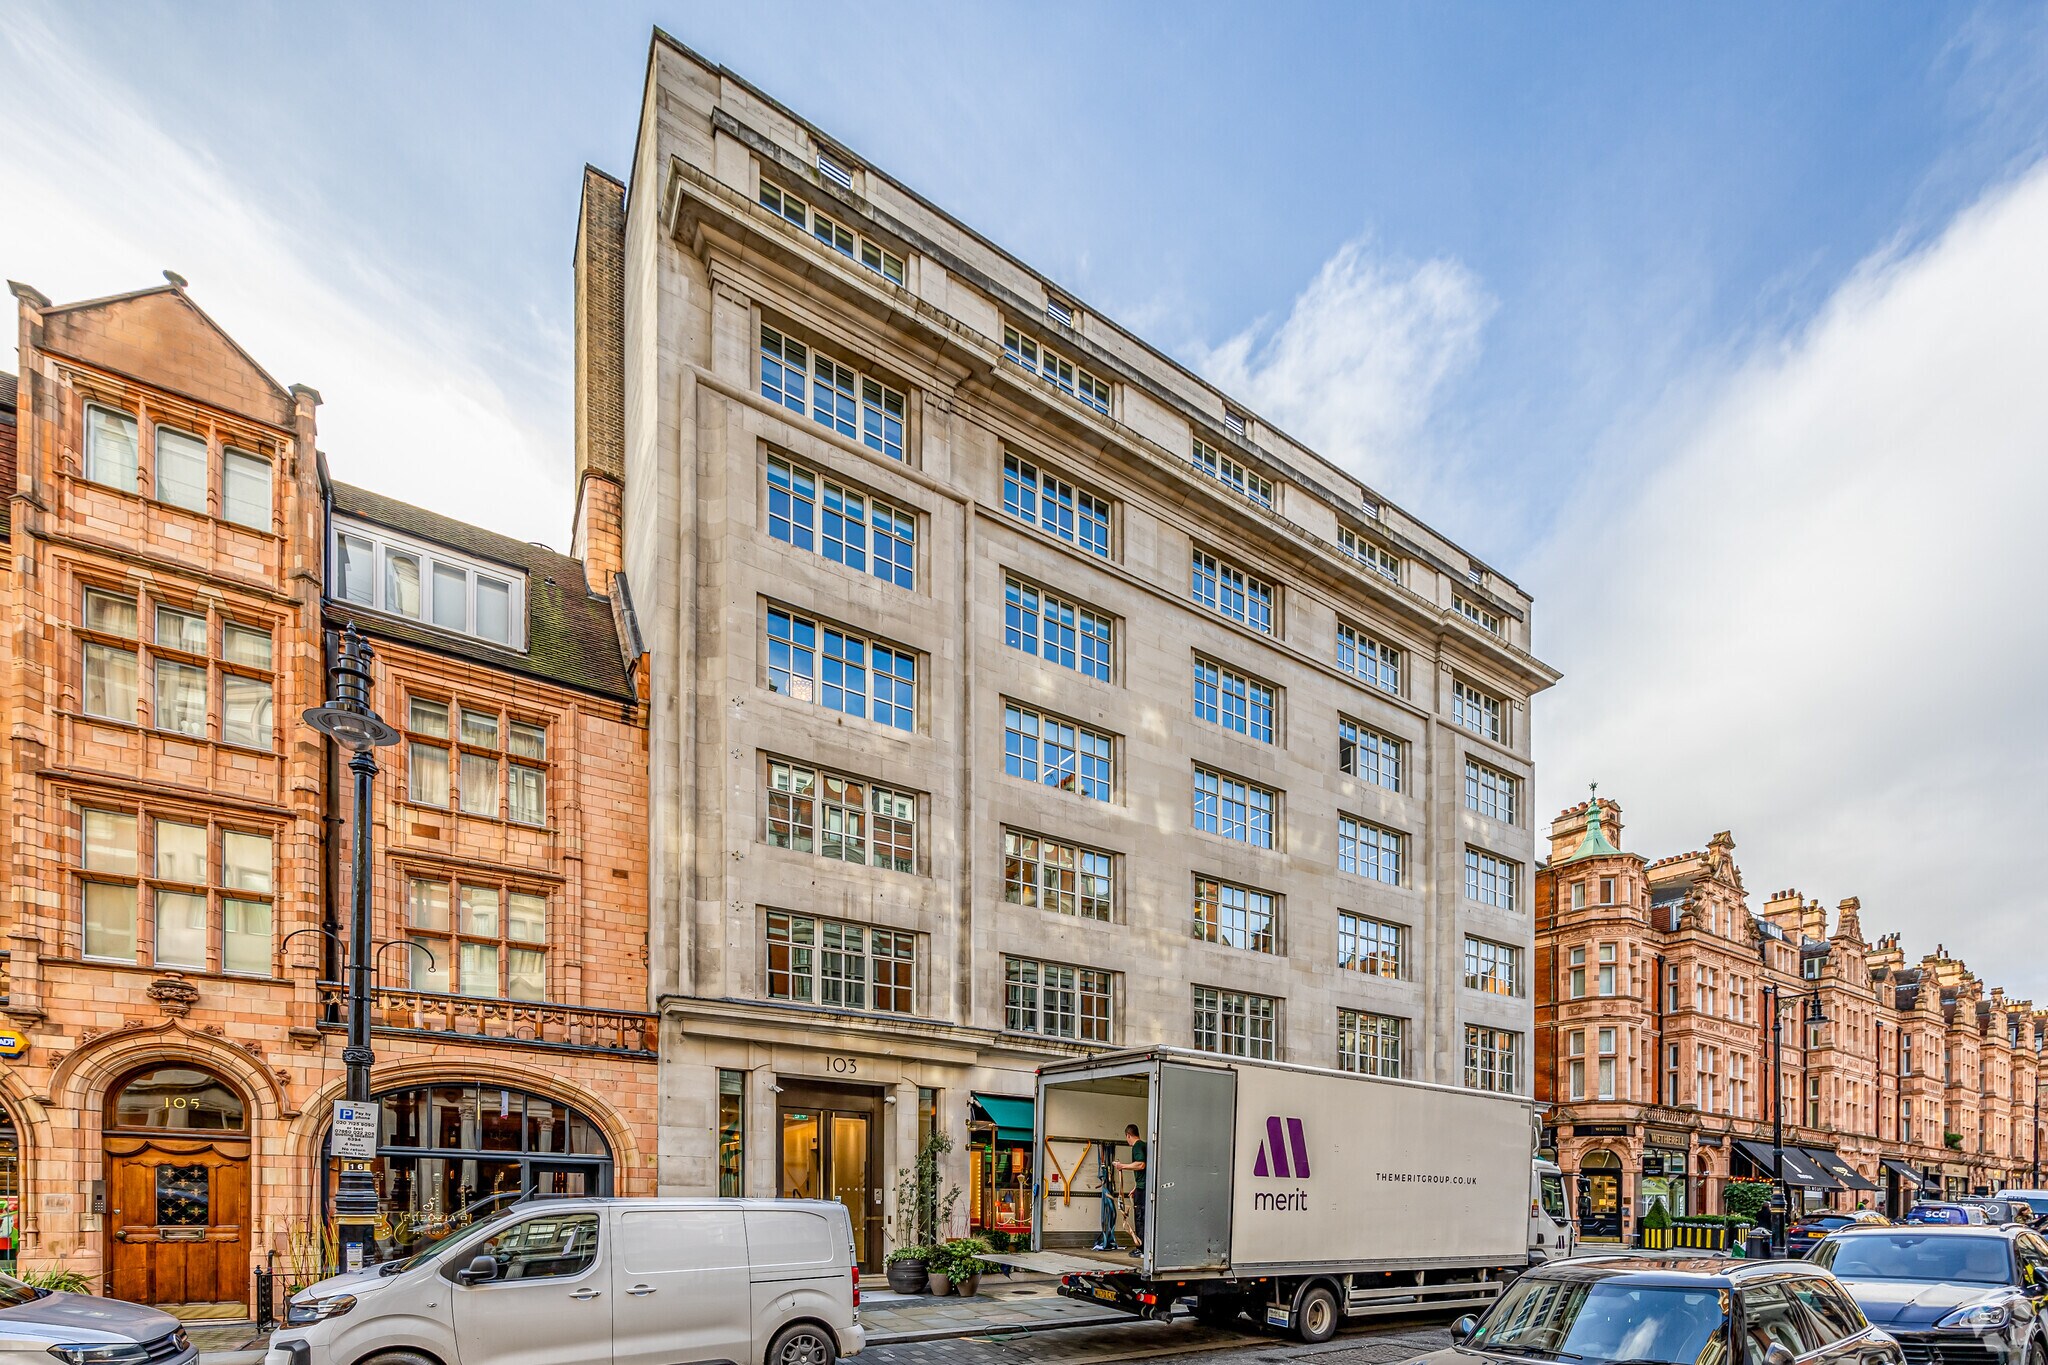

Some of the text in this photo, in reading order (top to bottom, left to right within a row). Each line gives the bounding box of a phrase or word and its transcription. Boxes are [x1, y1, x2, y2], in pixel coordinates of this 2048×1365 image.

[826, 1056, 857, 1074] 103
[165, 1097, 200, 1109] 105
[343, 1109, 352, 1119] P
[1651, 1132, 1685, 1146] WETHERELL
[1376, 1172, 1477, 1185] THEMERITGROUP.CO.UK
[1255, 1187, 1308, 1211] merit
[1925, 1210, 1950, 1218] SCCI
